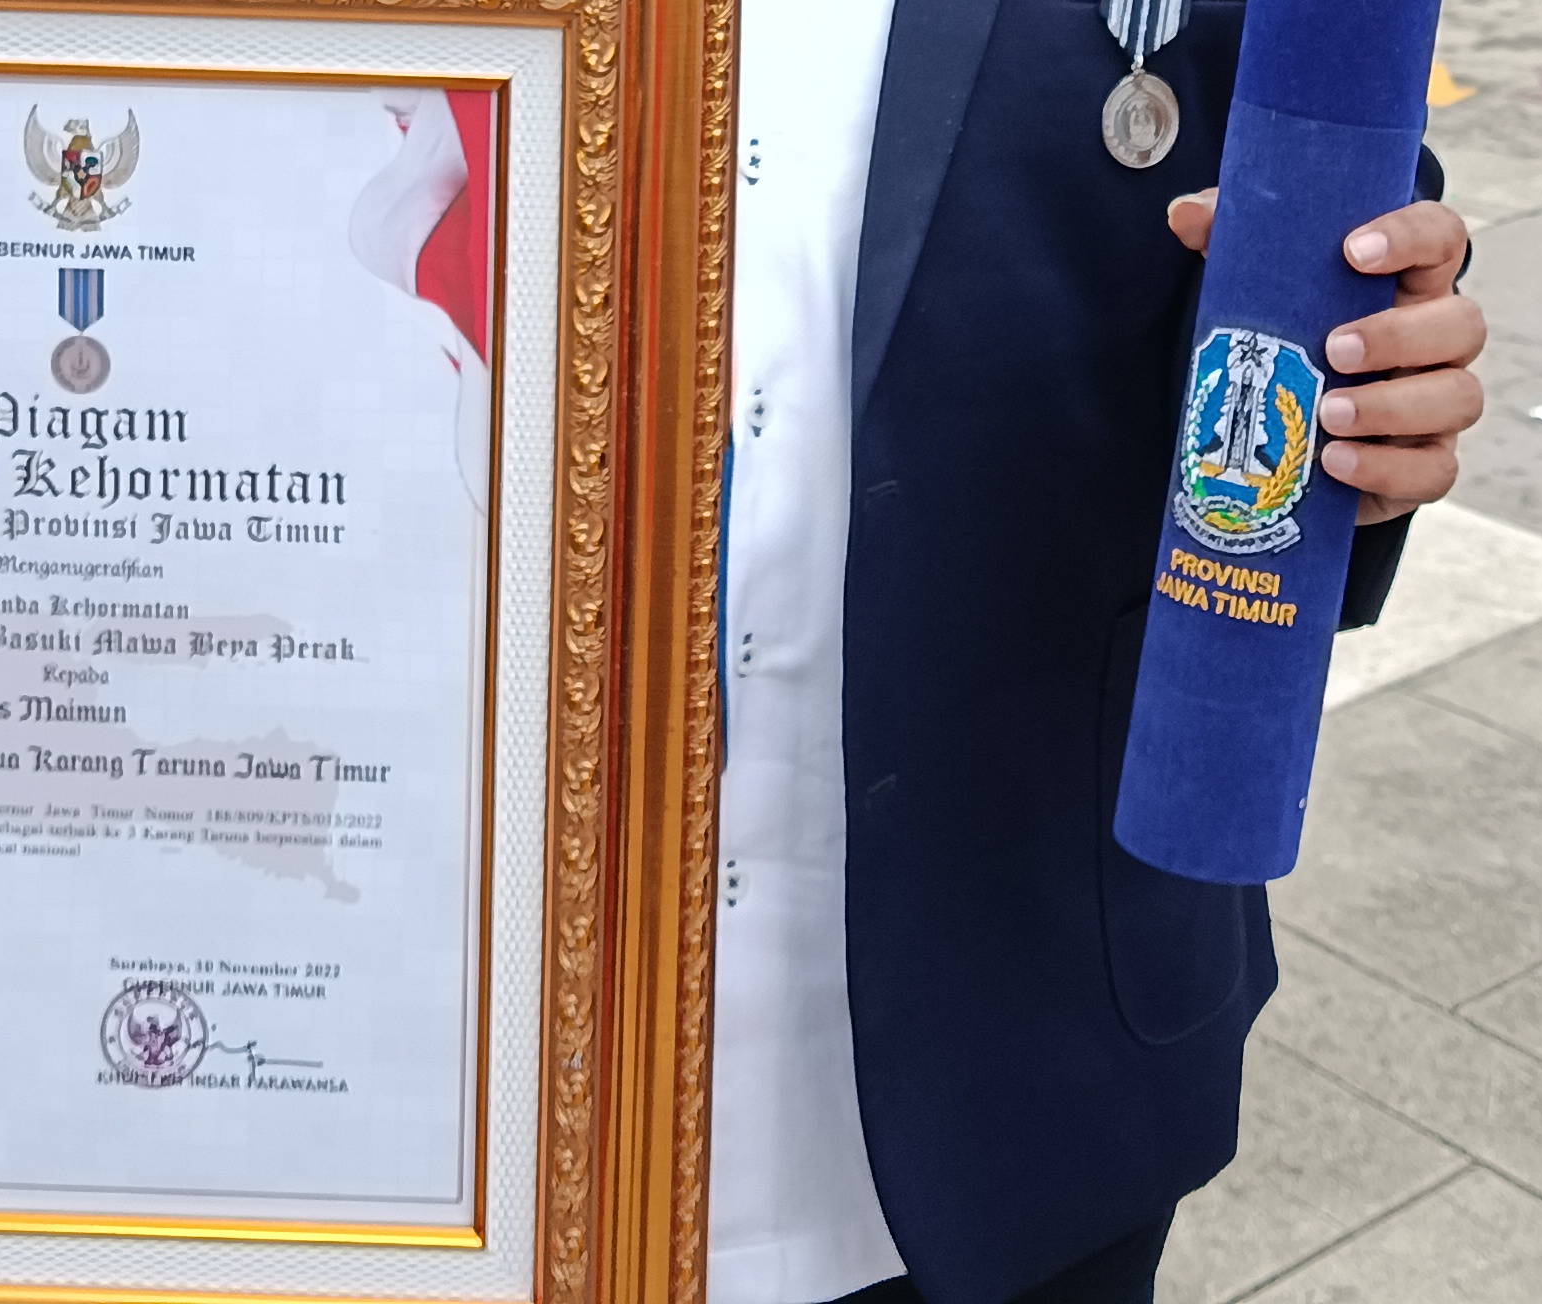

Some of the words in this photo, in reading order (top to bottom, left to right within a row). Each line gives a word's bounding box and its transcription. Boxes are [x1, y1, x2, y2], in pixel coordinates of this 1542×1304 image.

[80, 243, 132, 260] JAWA
[137, 244, 196, 262] TIMUR
[12, 448, 347, 509] Kehormatan
[2, 507, 138, 541] Provinsi
[150, 512, 233, 545] Jawa
[246, 515, 346, 545] Timur
[1169, 548, 1281, 598] PROVINSI
[49, 594, 189, 620] Kehormatan
[1156, 571, 1210, 611] JAWA
[1212, 590, 1298, 628] TIMUR
[92, 628, 177, 656] Mawa
[271, 633, 355, 663] Perak
[42, 662, 110, 688] Kepada
[18, 695, 126, 724] Maimun
[27, 745, 124, 780] Karang
[131, 748, 226, 777] Taruna
[233, 752, 302, 780] Jawa
[309, 754, 391, 783] Timur
[222, 981, 269, 997] JAWA
[273, 983, 327, 1000] TIMUR
